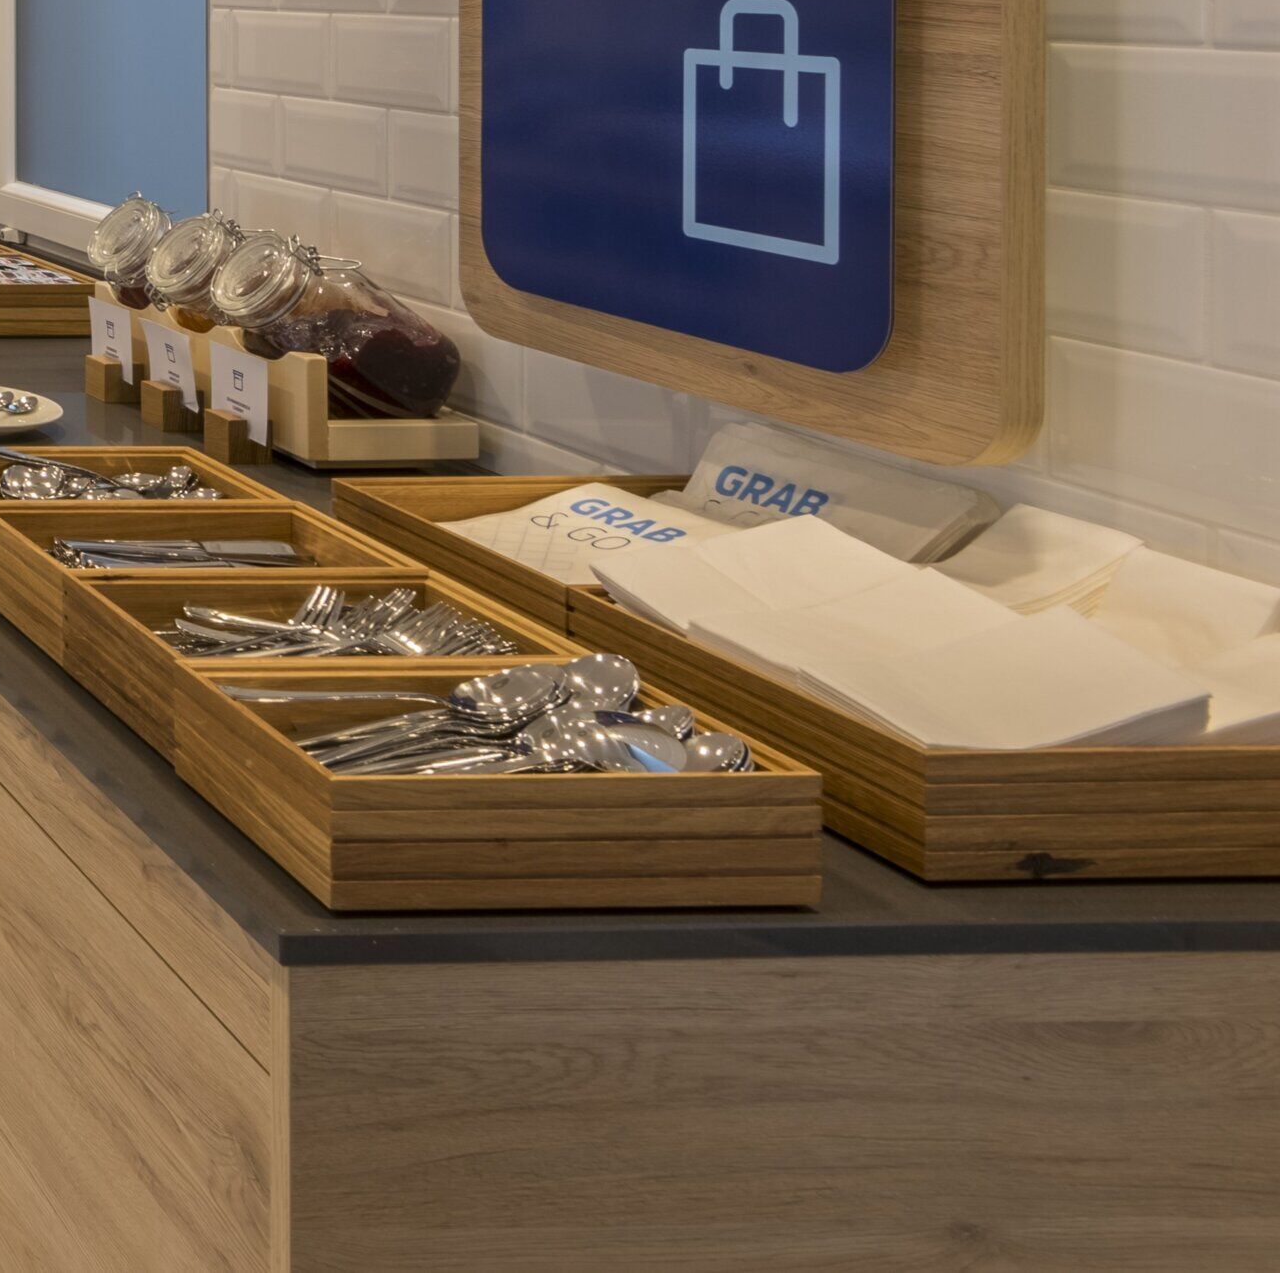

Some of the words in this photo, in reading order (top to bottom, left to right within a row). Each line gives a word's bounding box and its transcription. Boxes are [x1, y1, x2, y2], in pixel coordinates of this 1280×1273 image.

[714, 464, 830, 517] GRAB
[530, 511, 570, 530] &
[567, 526, 632, 550] GO
[569, 498, 688, 544] GRAB
